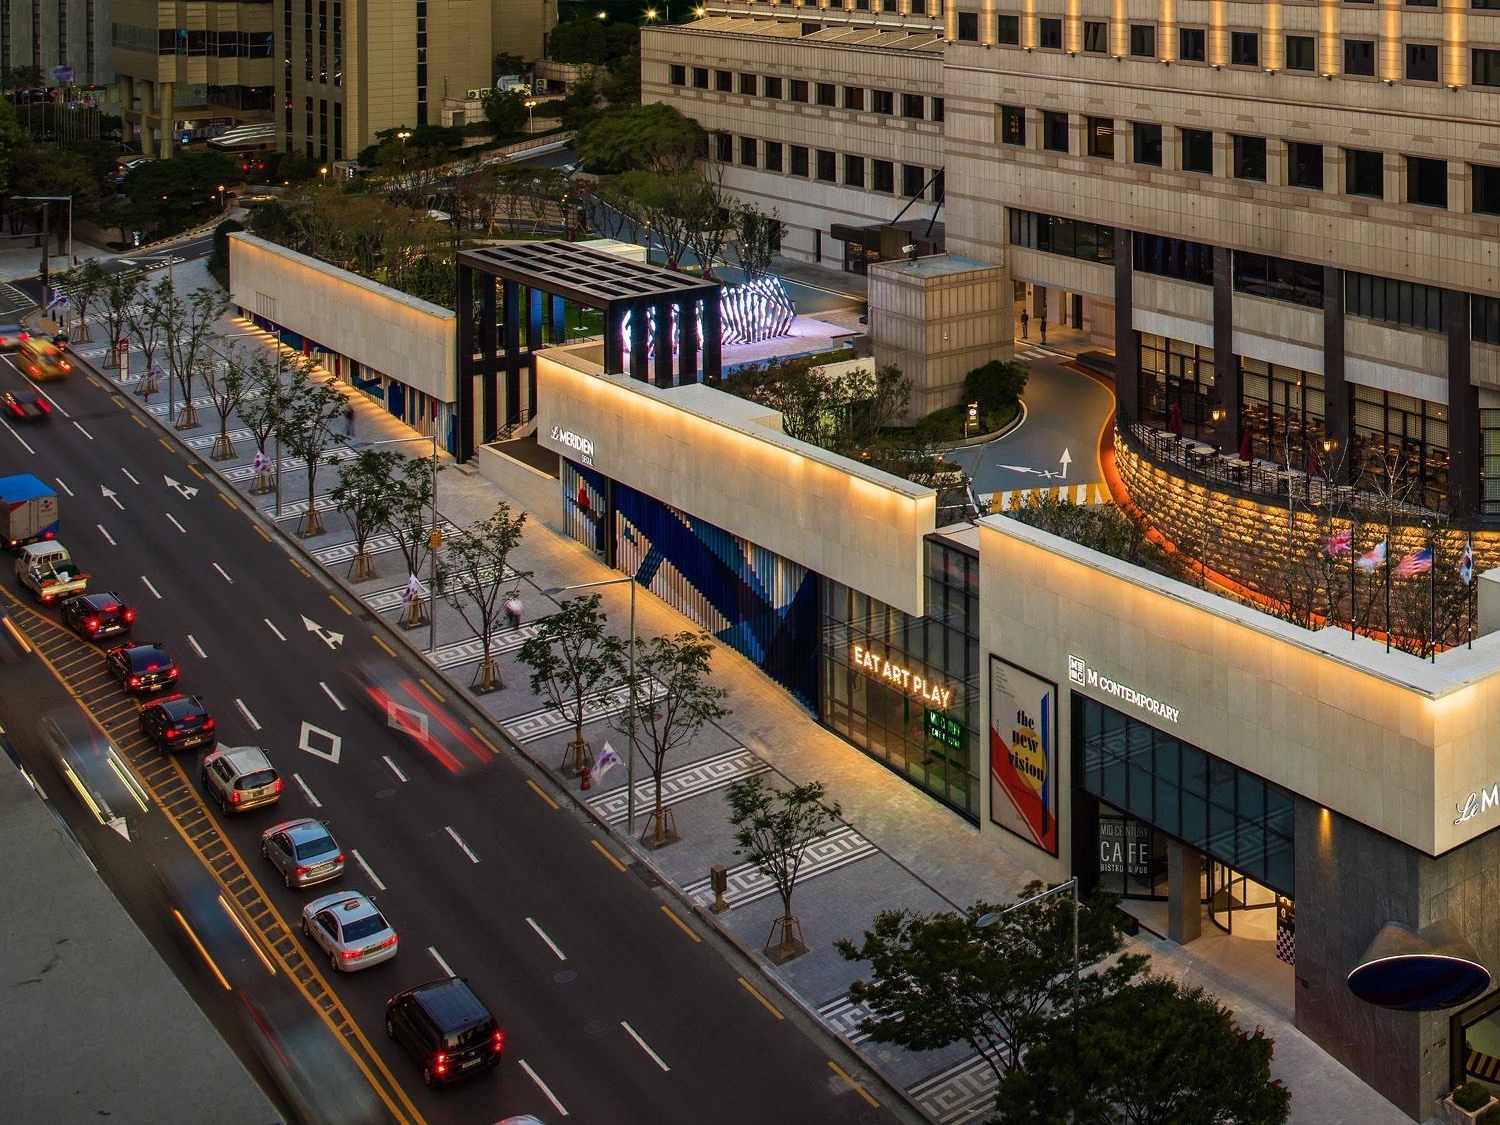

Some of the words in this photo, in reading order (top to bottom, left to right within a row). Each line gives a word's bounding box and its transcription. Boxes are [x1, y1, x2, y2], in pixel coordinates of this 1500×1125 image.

[560, 428, 595, 457] MERIDIEN
[854, 645, 881, 673] EAT
[882, 661, 911, 688] ART
[913, 675, 951, 708] PLAY
[1087, 668, 1098, 688] M
[1099, 676, 1180, 723] CONTEMPORARY
[1017, 709, 1035, 730] the
[1012, 729, 1039, 754] new
[1008, 751, 1045, 783] vision
[1453, 792, 1479, 825] Le
[1101, 824, 1113, 836] MID
[1100, 841, 1148, 864] CAFE
[1100, 863, 1124, 873] BISTRO
[1134, 866, 1148, 874] PUB
